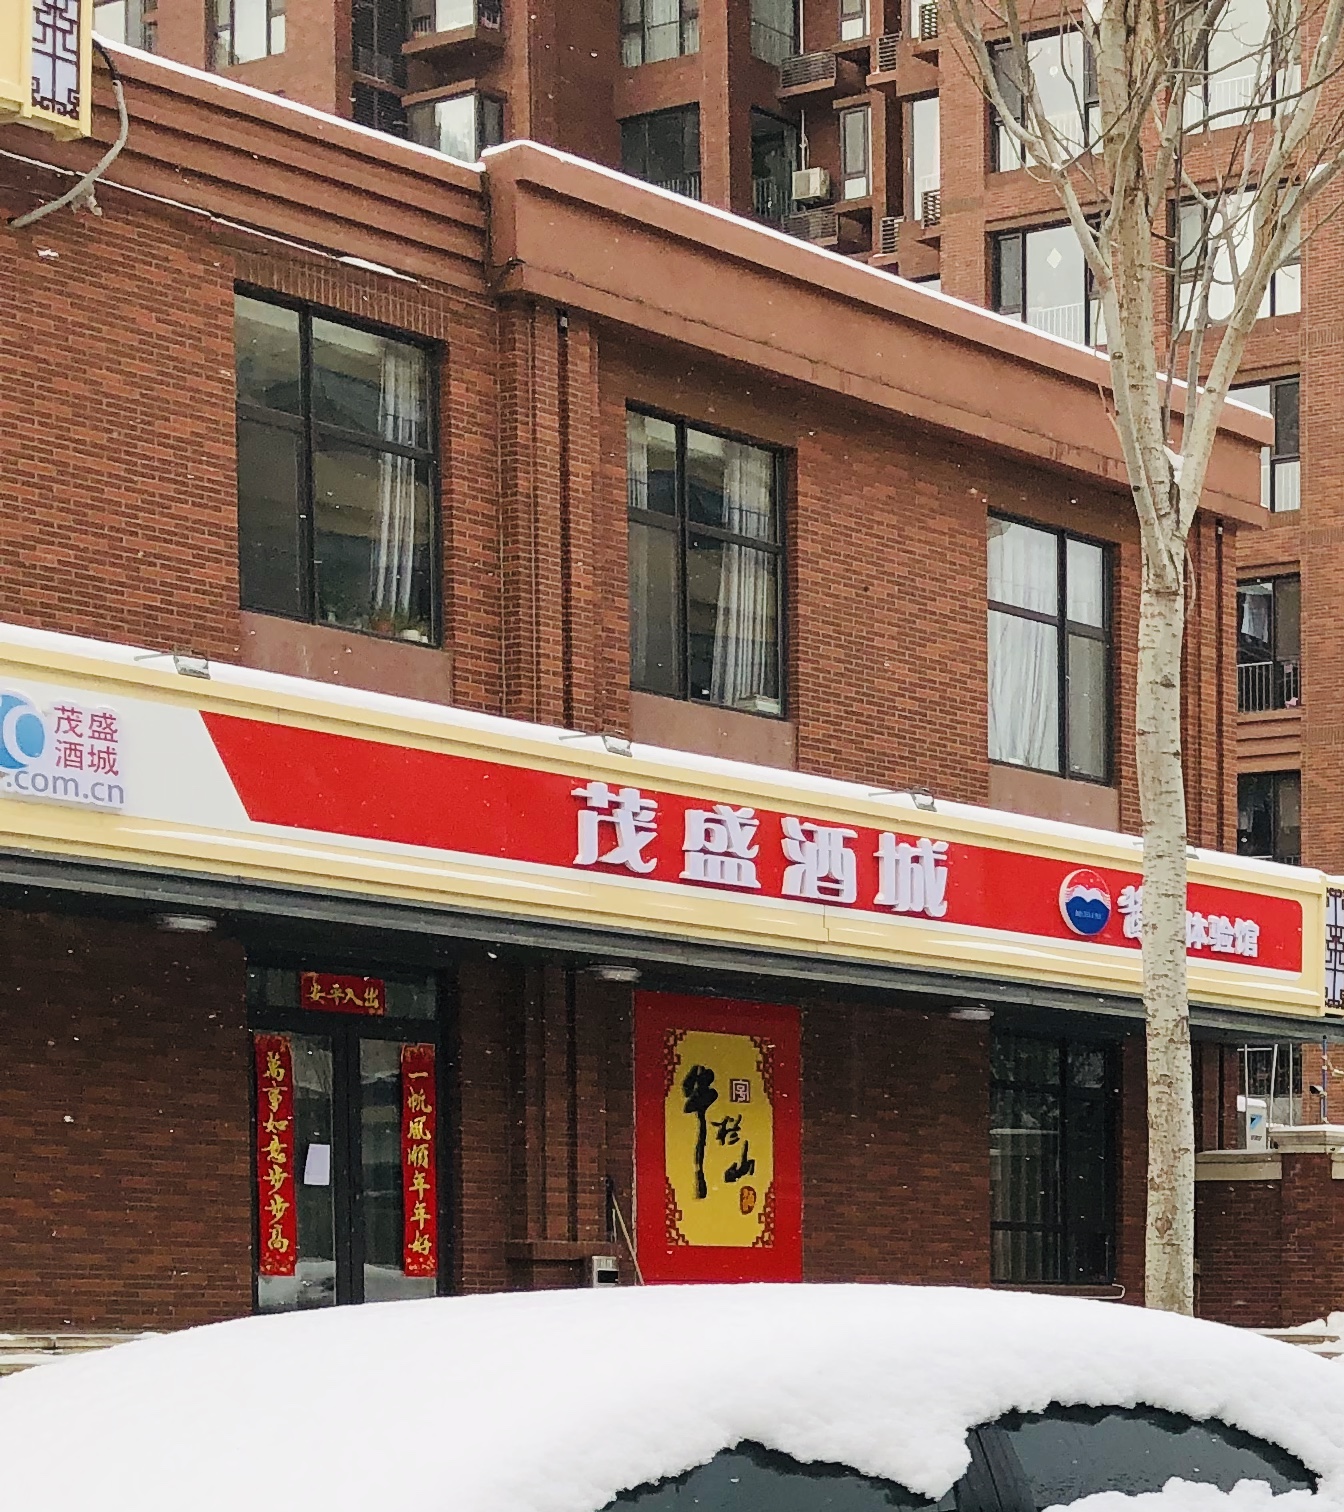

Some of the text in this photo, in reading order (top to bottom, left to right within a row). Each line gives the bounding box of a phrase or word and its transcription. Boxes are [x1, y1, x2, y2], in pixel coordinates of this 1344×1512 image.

[53, 705, 119, 744] 茂盛
[54, 738, 120, 777] 酒城
[571, 780, 950, 920] 茂盛酒城
